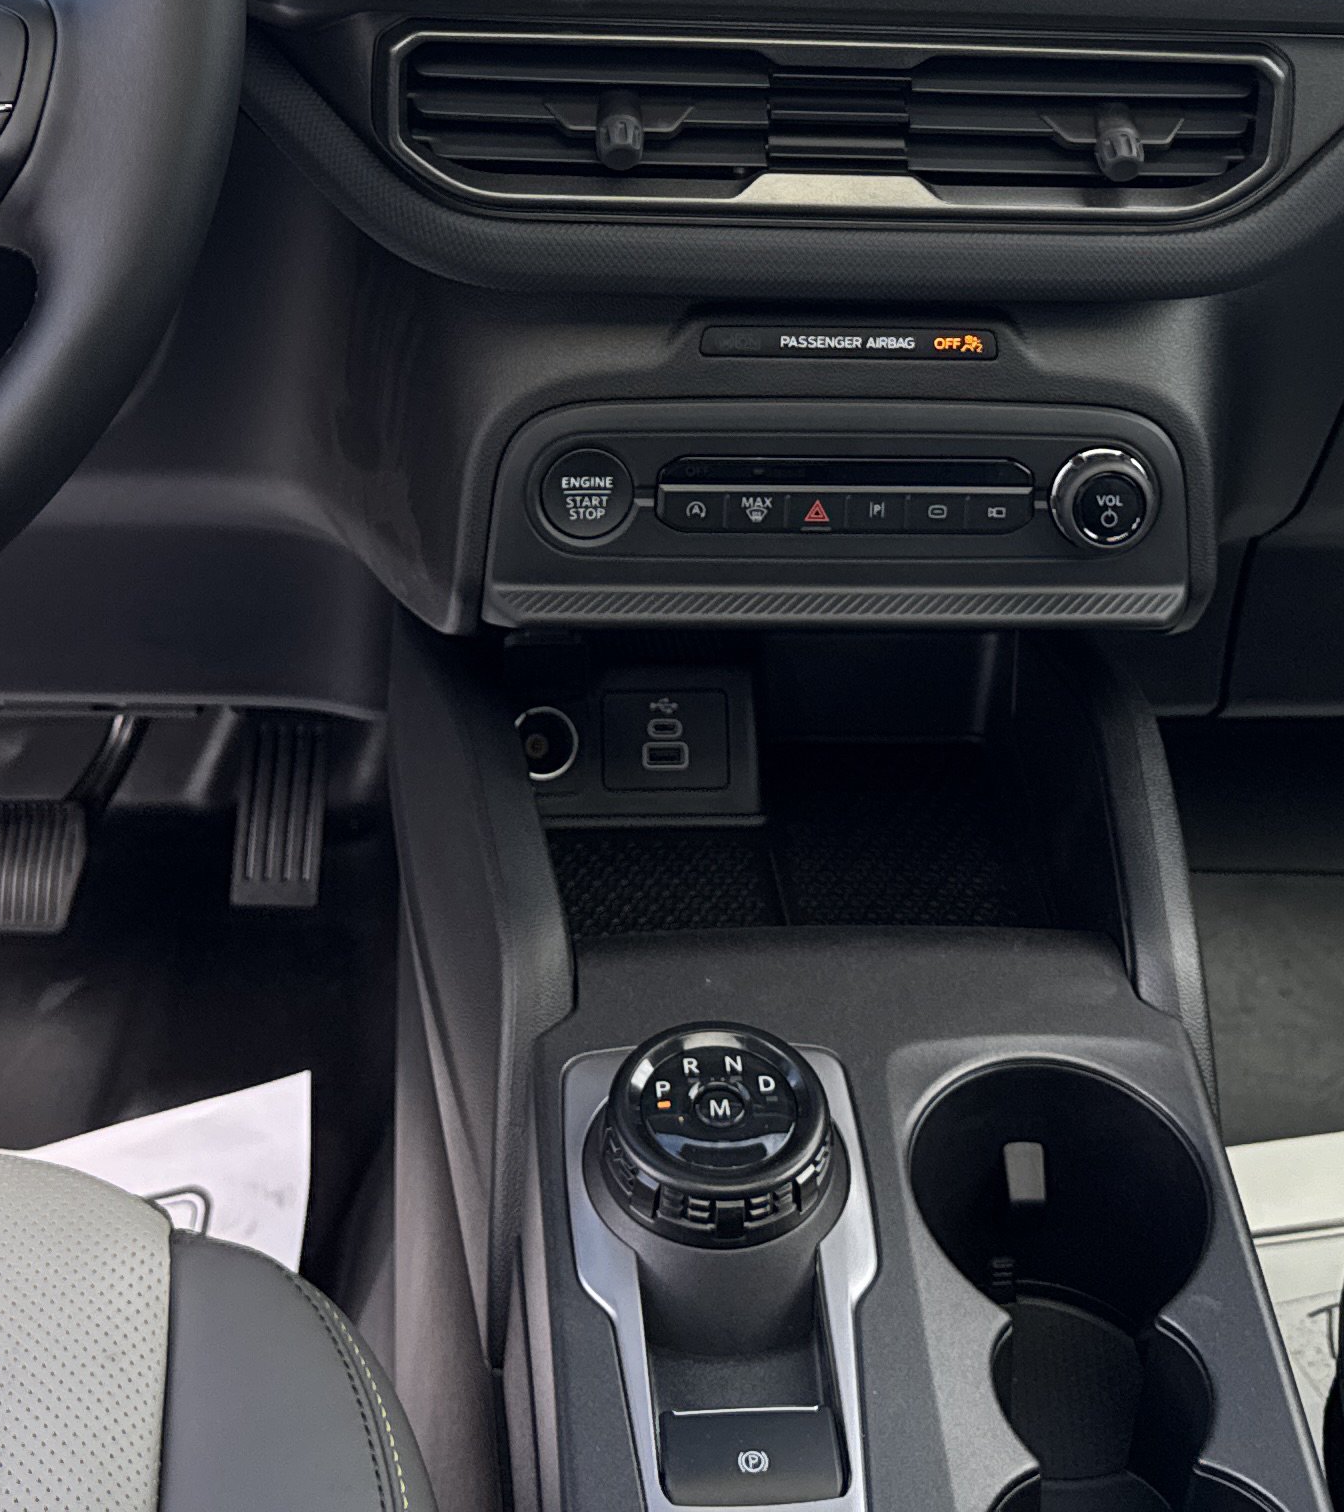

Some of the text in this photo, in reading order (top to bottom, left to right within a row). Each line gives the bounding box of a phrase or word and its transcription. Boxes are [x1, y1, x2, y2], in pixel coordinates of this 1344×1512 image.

[780, 335, 961, 352] PASSENGER AIRBAG OFF
[561, 475, 614, 489] ENGINE
[565, 495, 609, 509] START
[740, 497, 773, 509] MAX
[1096, 495, 1123, 508] VOL
[569, 508, 606, 521] STOP
[682, 1057, 700, 1075] R
[725, 1055, 743, 1073] N
[656, 1080, 671, 1098] P
[758, 1075, 776, 1093] D
[709, 1099, 731, 1118] M
